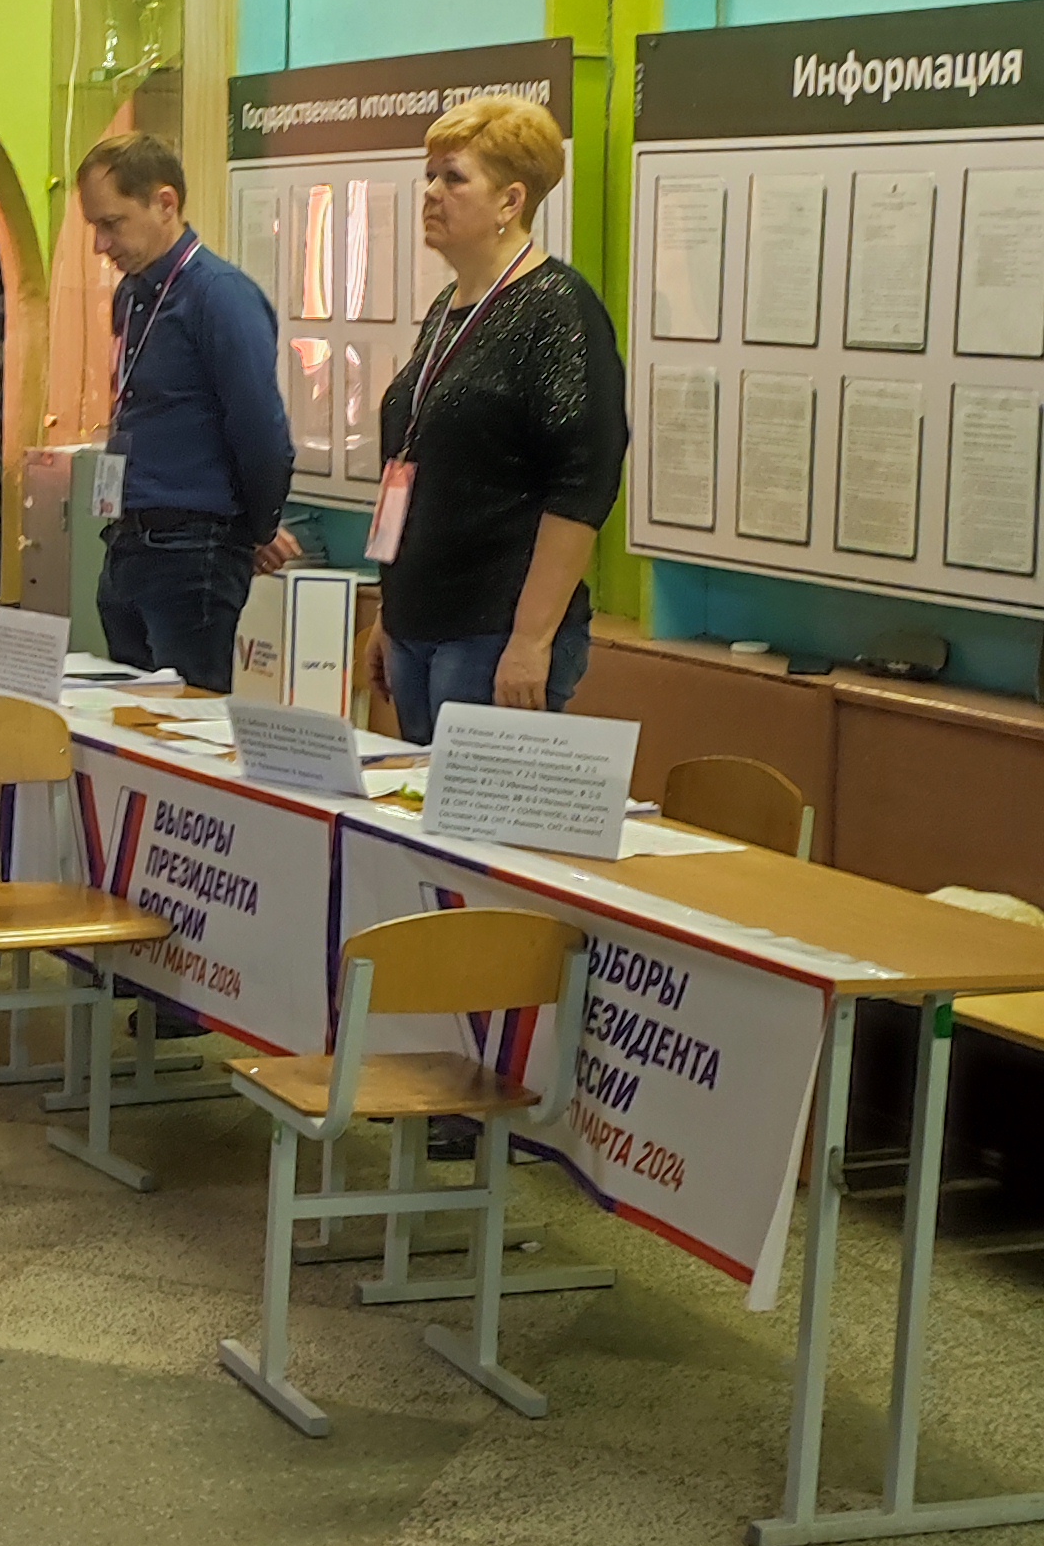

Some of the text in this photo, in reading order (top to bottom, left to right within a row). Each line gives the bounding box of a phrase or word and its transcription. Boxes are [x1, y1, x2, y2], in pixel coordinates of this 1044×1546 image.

[792, 48, 1024, 105] Информация
[242, 97, 358, 135] Государственная
[360, 89, 439, 120] итоговая
[153, 800, 236, 857] ВЫБОРЫ
[145, 844, 259, 917] ПРЕЗИДЕНТА
[138, 887, 208, 943] РОССИИ
[163, 942, 208, 986] МАРТА
[208, 962, 242, 1000] 2024
[583, 933, 690, 1011] ЫБОРЫ
[583, 990, 721, 1091] ЕЗИДЕНТА
[575, 1047, 640, 1114] ССИИ
[580, 1108, 634, 1167] МАРТА
[633, 1141, 686, 1193] 2024
